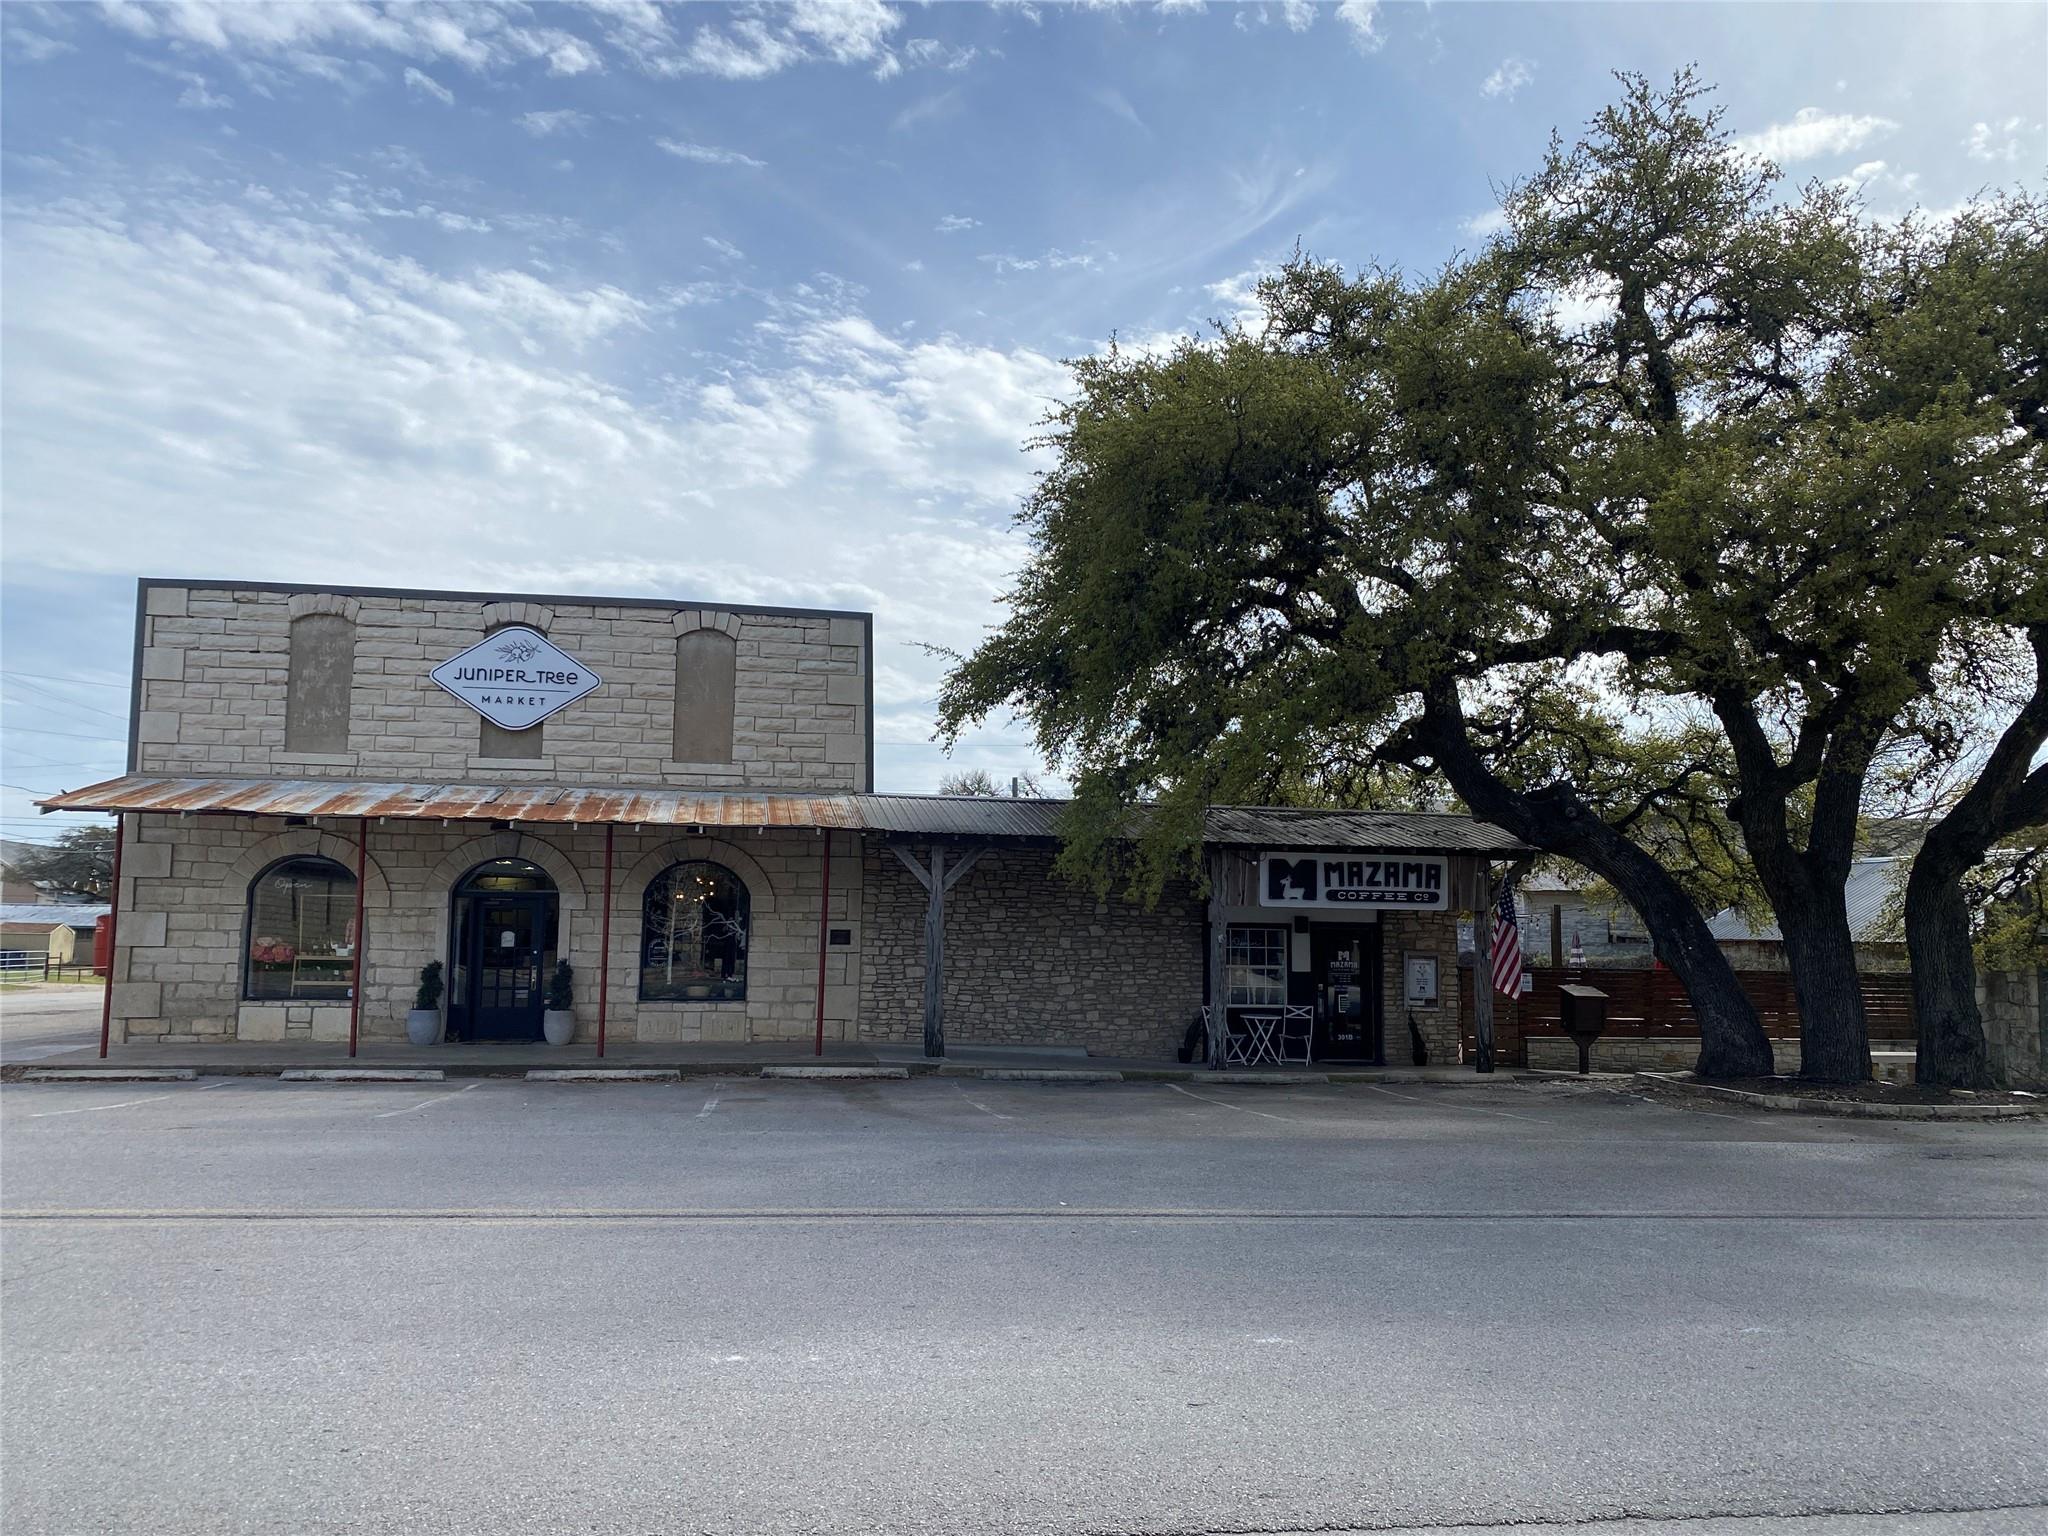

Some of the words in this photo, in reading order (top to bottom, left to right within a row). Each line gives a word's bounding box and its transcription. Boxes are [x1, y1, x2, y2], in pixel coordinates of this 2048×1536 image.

[481, 696, 546, 706] MARKET
[1323, 862, 1442, 889] MAZAMA
[1337, 891, 1408, 900] COFFEE
